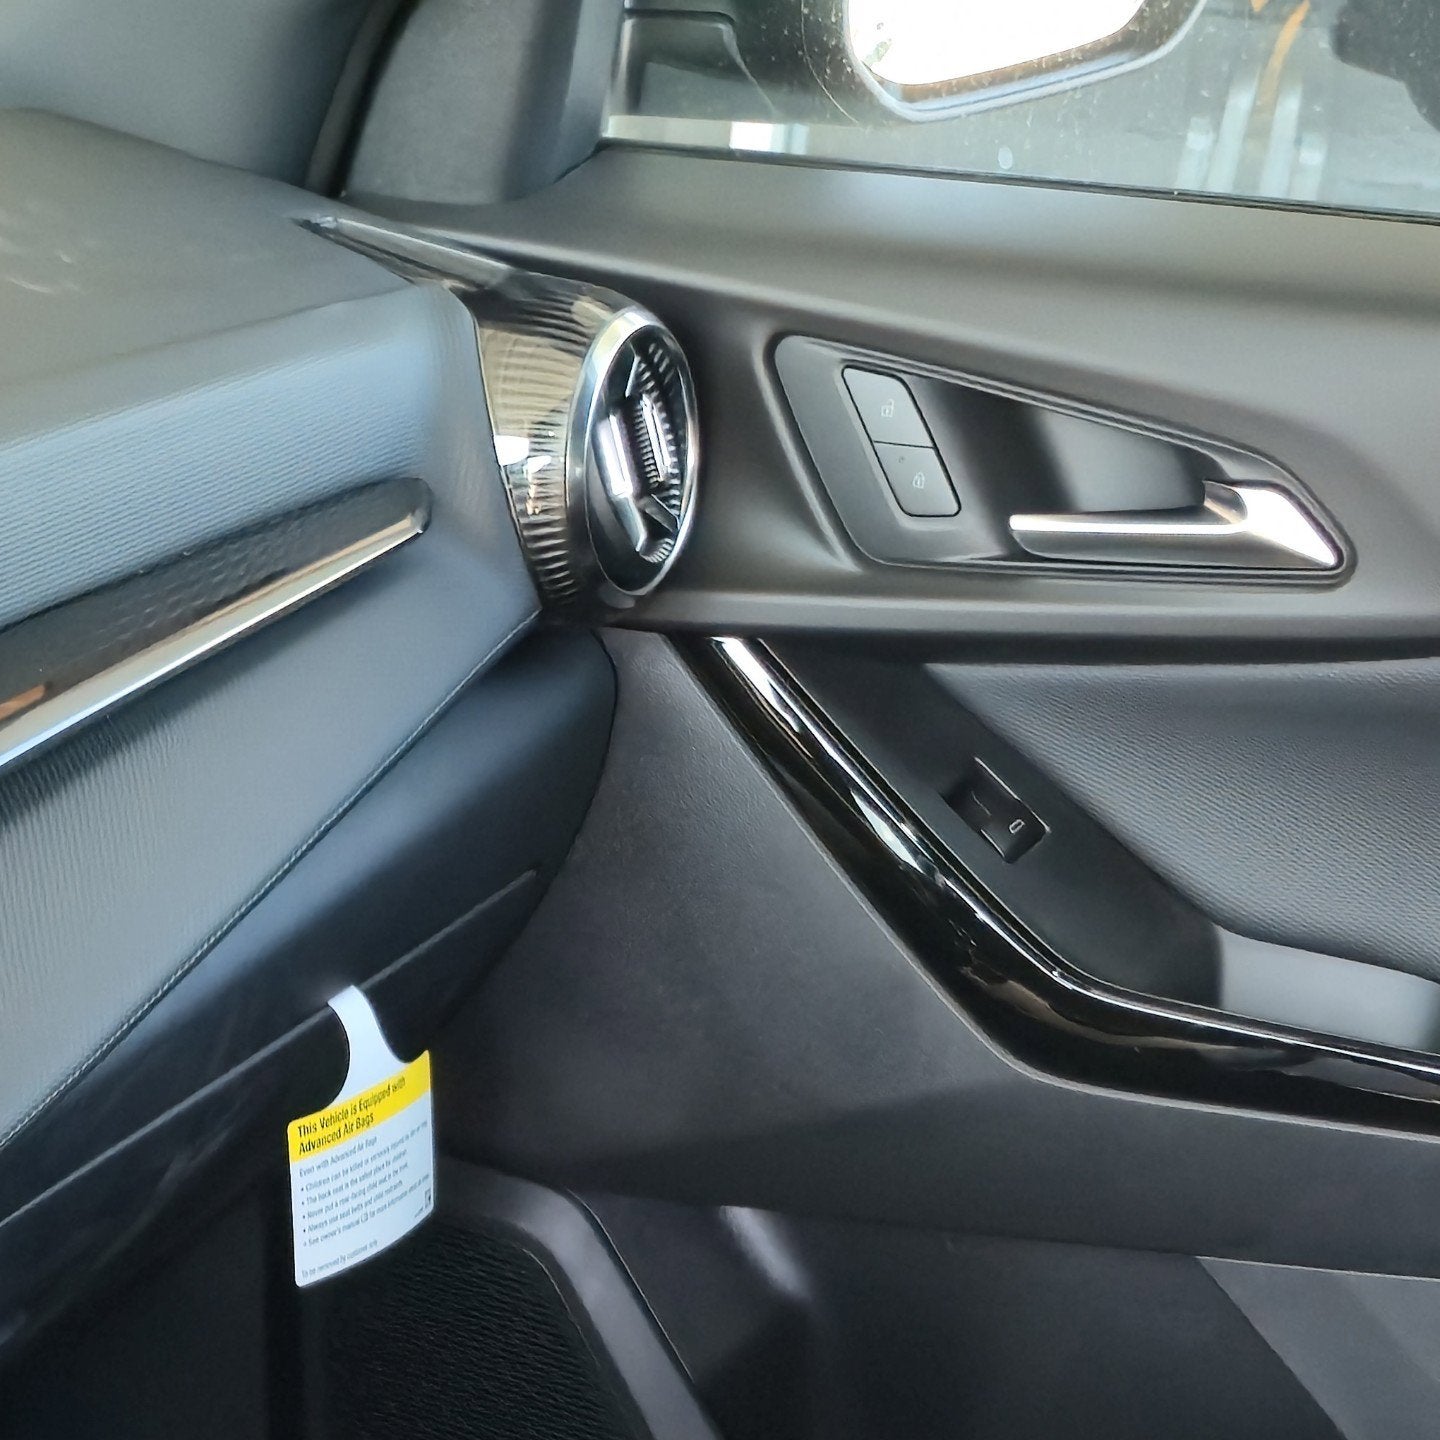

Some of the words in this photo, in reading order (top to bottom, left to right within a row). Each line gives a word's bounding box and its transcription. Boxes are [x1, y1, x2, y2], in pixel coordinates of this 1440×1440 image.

[298, 1122, 317, 1138] This
[320, 1108, 349, 1128] Vehicle
[350, 1104, 357, 1115] is
[358, 1084, 391, 1111] Equipped
[299, 1130, 341, 1155] Advanced
[343, 1120, 354, 1135] Air
[356, 1113, 374, 1130] Bags
